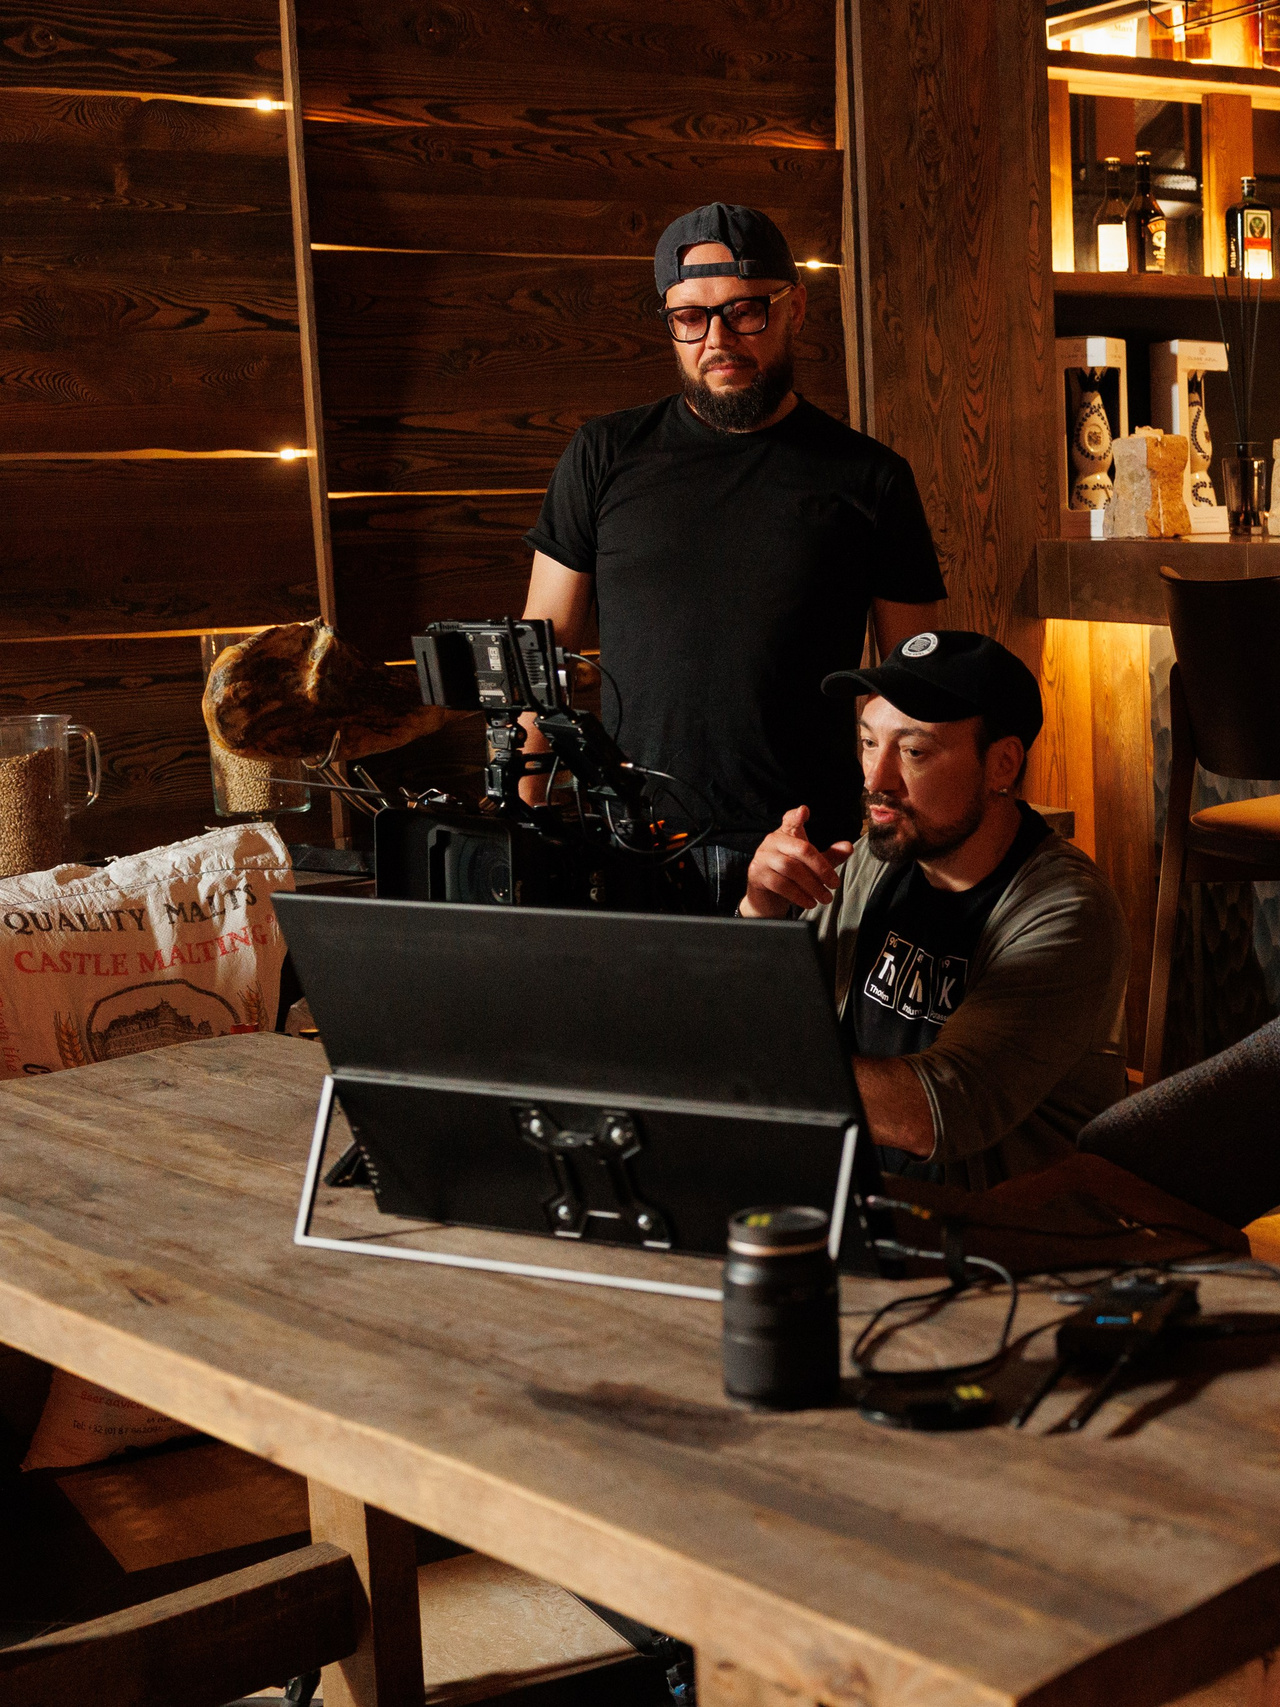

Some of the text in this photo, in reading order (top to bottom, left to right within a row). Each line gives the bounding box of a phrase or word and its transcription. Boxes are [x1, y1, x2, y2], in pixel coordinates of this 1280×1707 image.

[4, 884, 257, 936] QUALITY MALTS
[14, 926, 267, 977] CASTLE MALTING
[938, 976, 957, 1010] K
